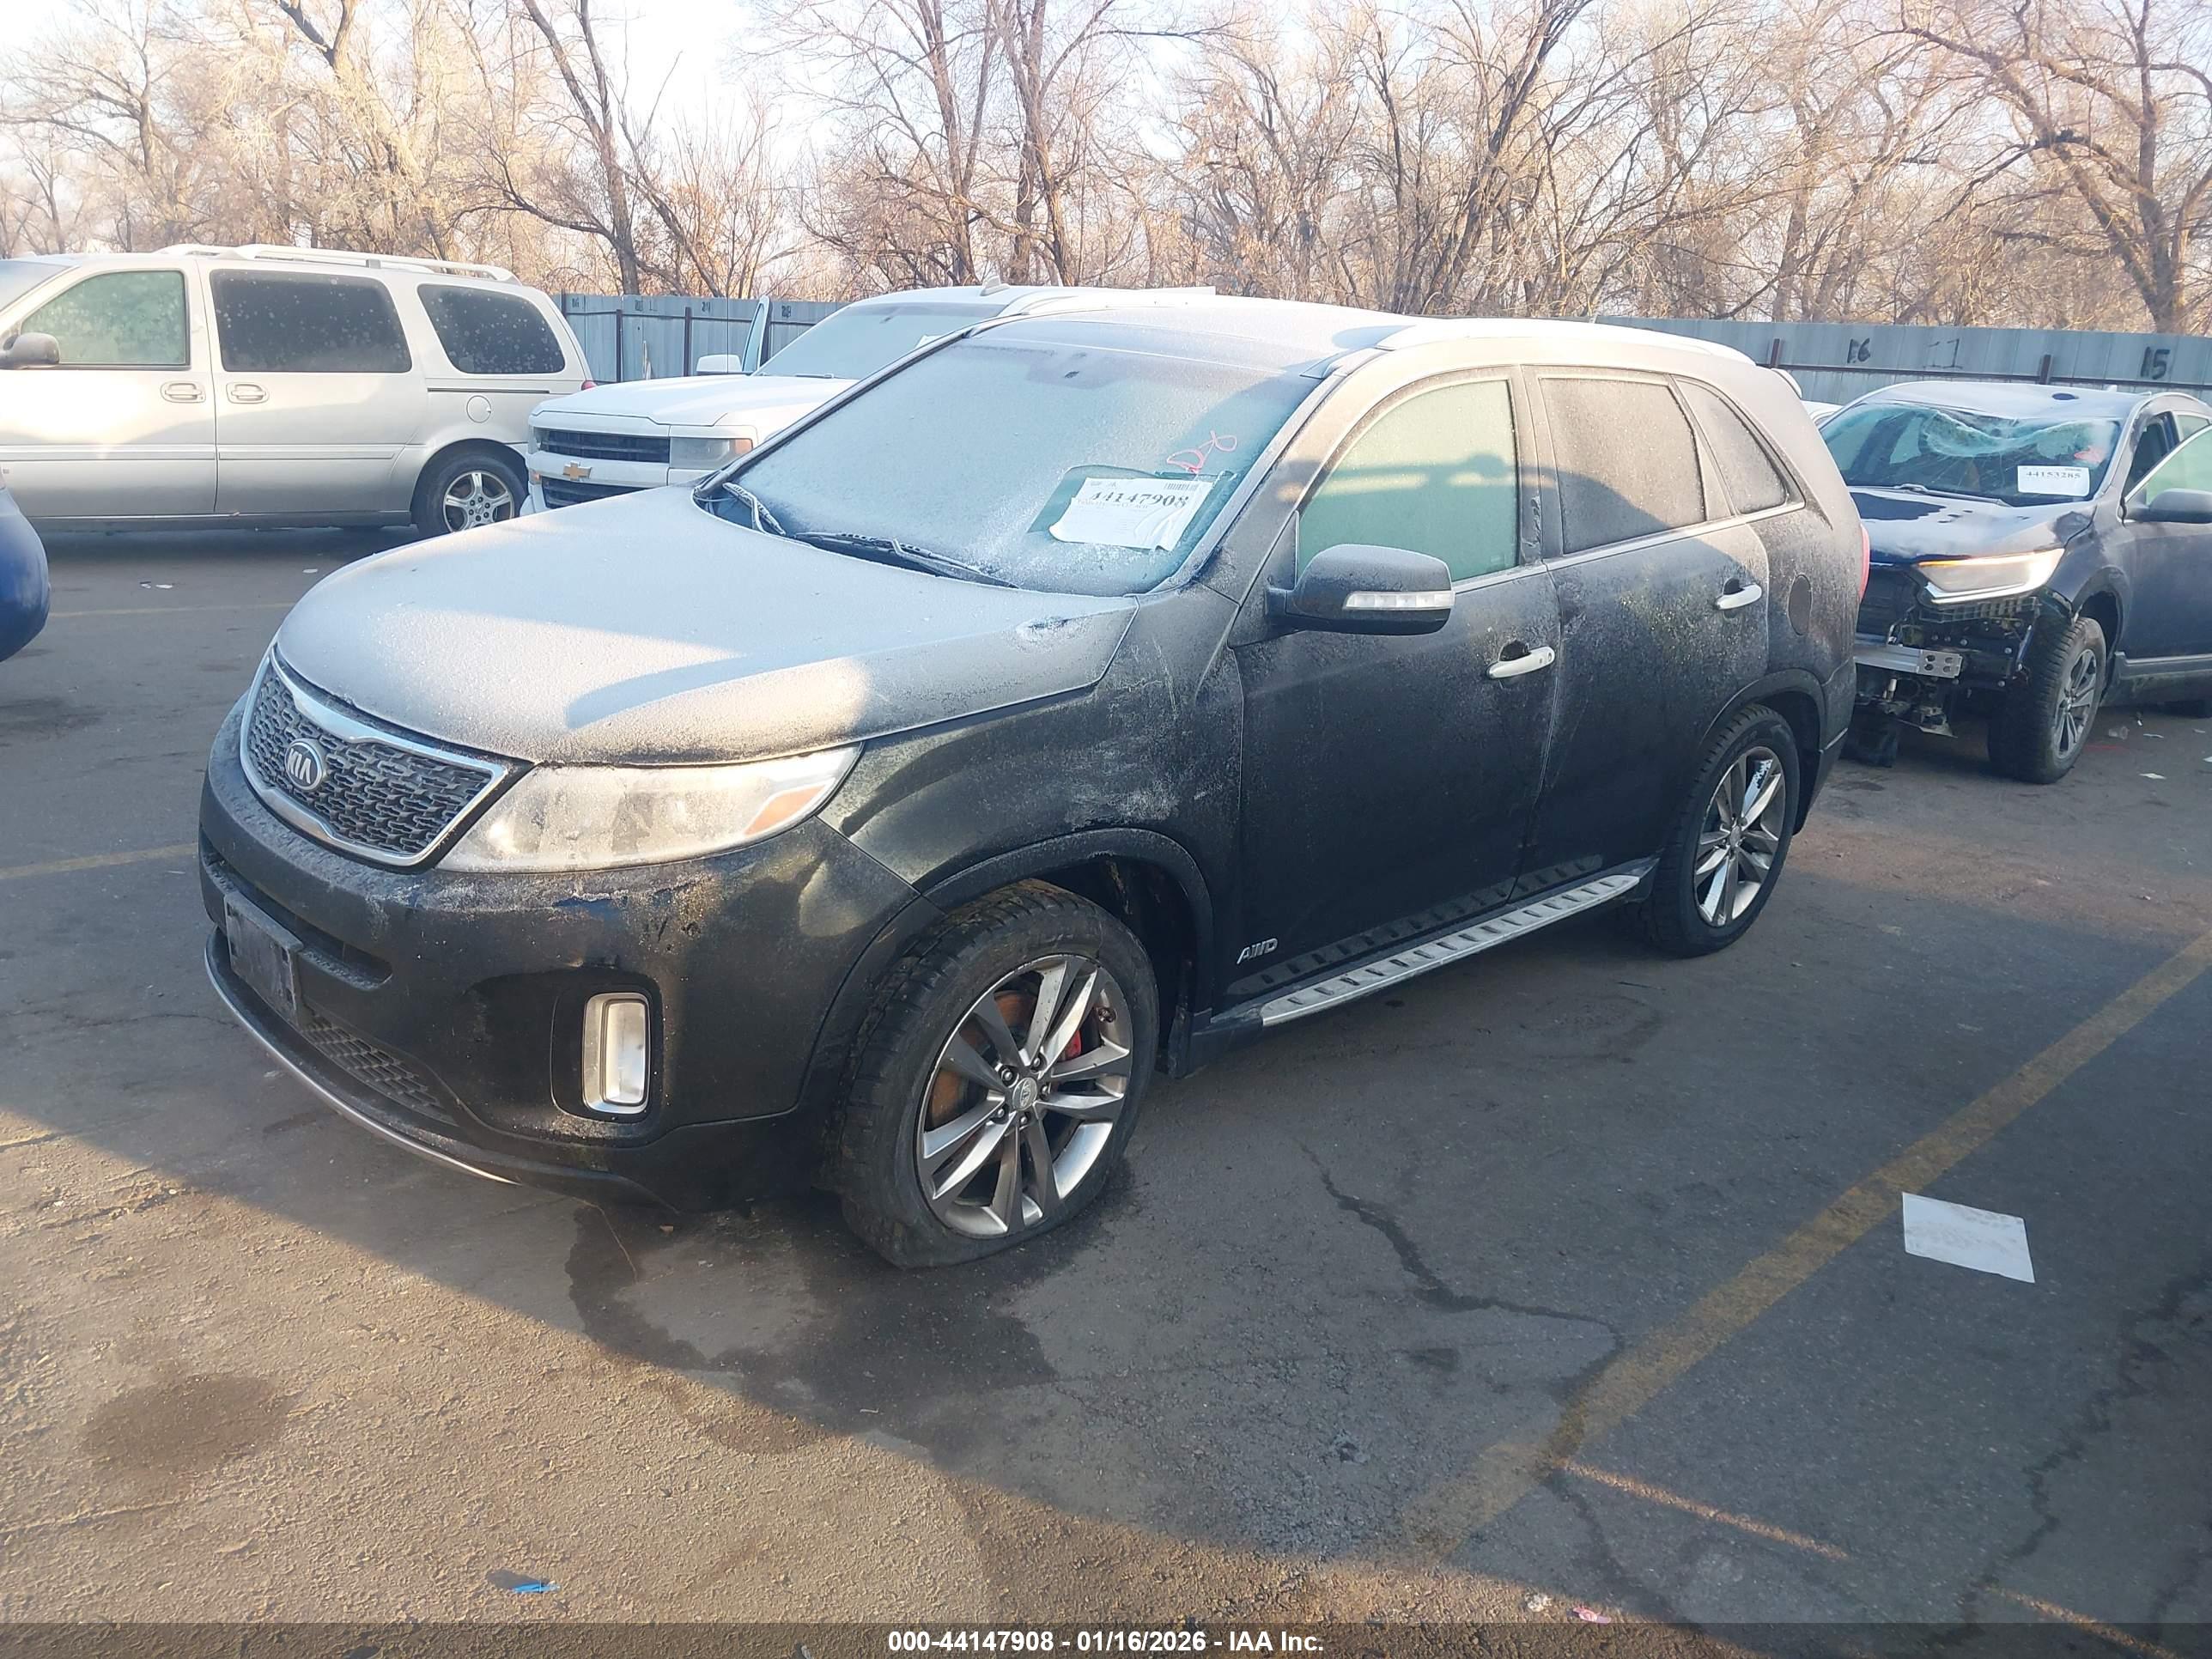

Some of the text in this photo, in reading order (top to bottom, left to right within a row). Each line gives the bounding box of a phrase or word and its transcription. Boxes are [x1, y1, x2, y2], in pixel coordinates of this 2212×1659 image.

[2140, 346, 2170, 380] 15
[1091, 491, 1189, 508] 44147908
[1237, 938, 1279, 964] AWD
